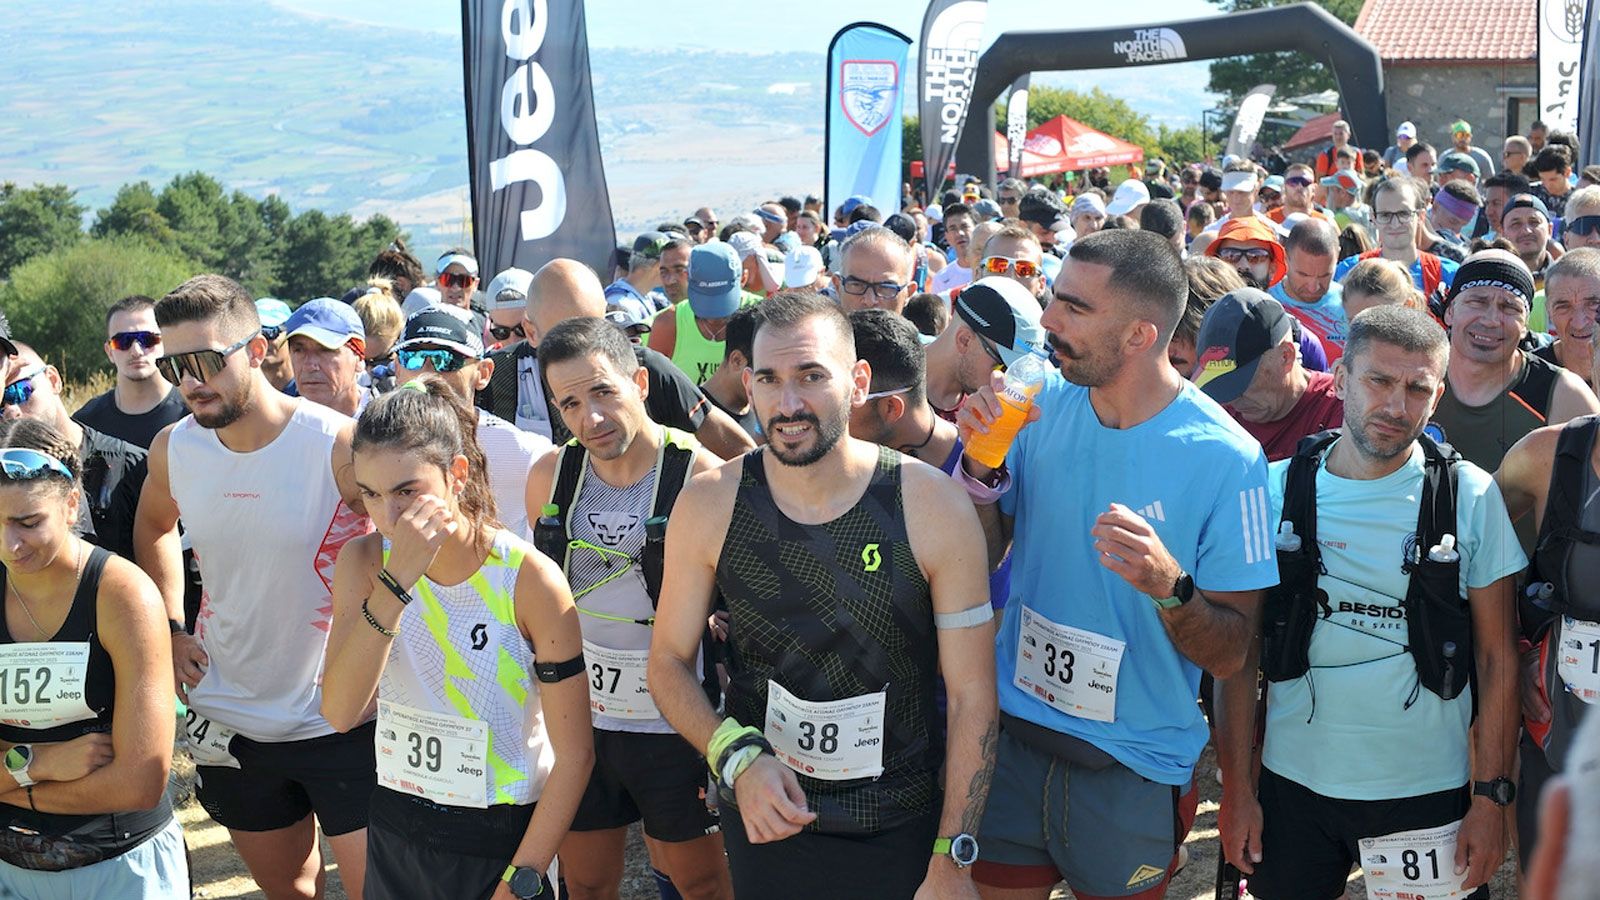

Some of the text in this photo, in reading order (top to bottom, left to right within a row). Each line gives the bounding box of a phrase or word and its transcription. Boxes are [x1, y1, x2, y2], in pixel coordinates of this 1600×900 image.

[1134, 29, 1160, 41] THE
[1113, 39, 1160, 54] NORTH
[1128, 51, 1161, 63] FACE
[925, 47, 946, 102] THE
[941, 50, 966, 144] NORTH
[1351, 619, 1401, 630] BE SAFE
[1044, 643, 1075, 685] 33
[0, 667, 51, 705] 152
[592, 663, 622, 694] 37
[1088, 680, 1113, 694] Jeep
[56, 690, 81, 700] Jeep
[798, 721, 839, 754] 38
[854, 737, 880, 748] Jeep
[211, 739, 227, 752] Jeep
[407, 732, 442, 773] 39
[457, 764, 483, 777] Jeep
[1402, 848, 1439, 880] 81
